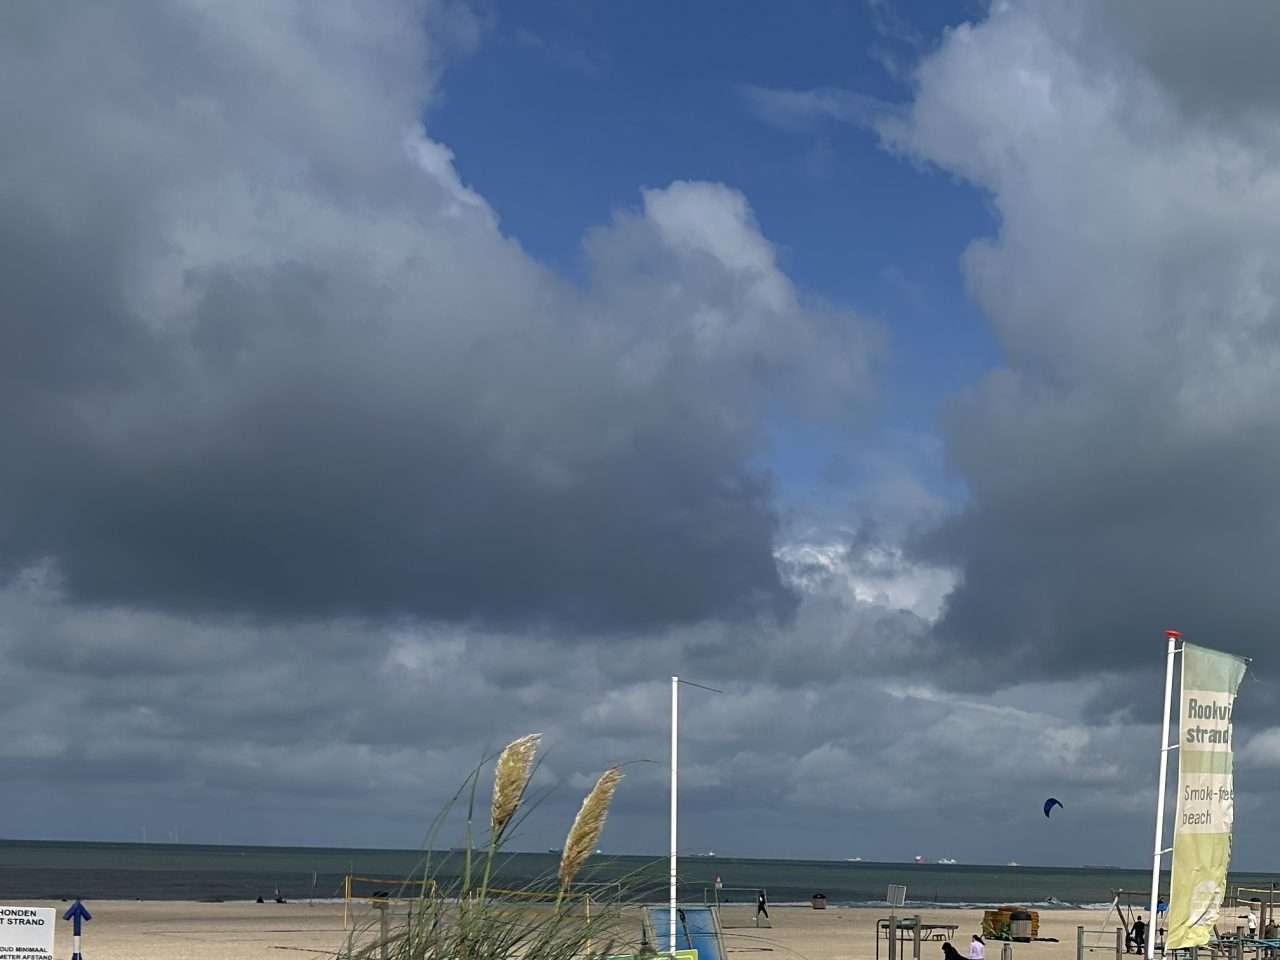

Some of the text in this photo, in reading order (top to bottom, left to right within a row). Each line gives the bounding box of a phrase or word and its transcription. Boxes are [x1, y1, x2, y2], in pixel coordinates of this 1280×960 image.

[1186, 725, 1229, 744] strand
[1182, 810, 1212, 825] beach
[7, 918, 45, 926] STRAND
